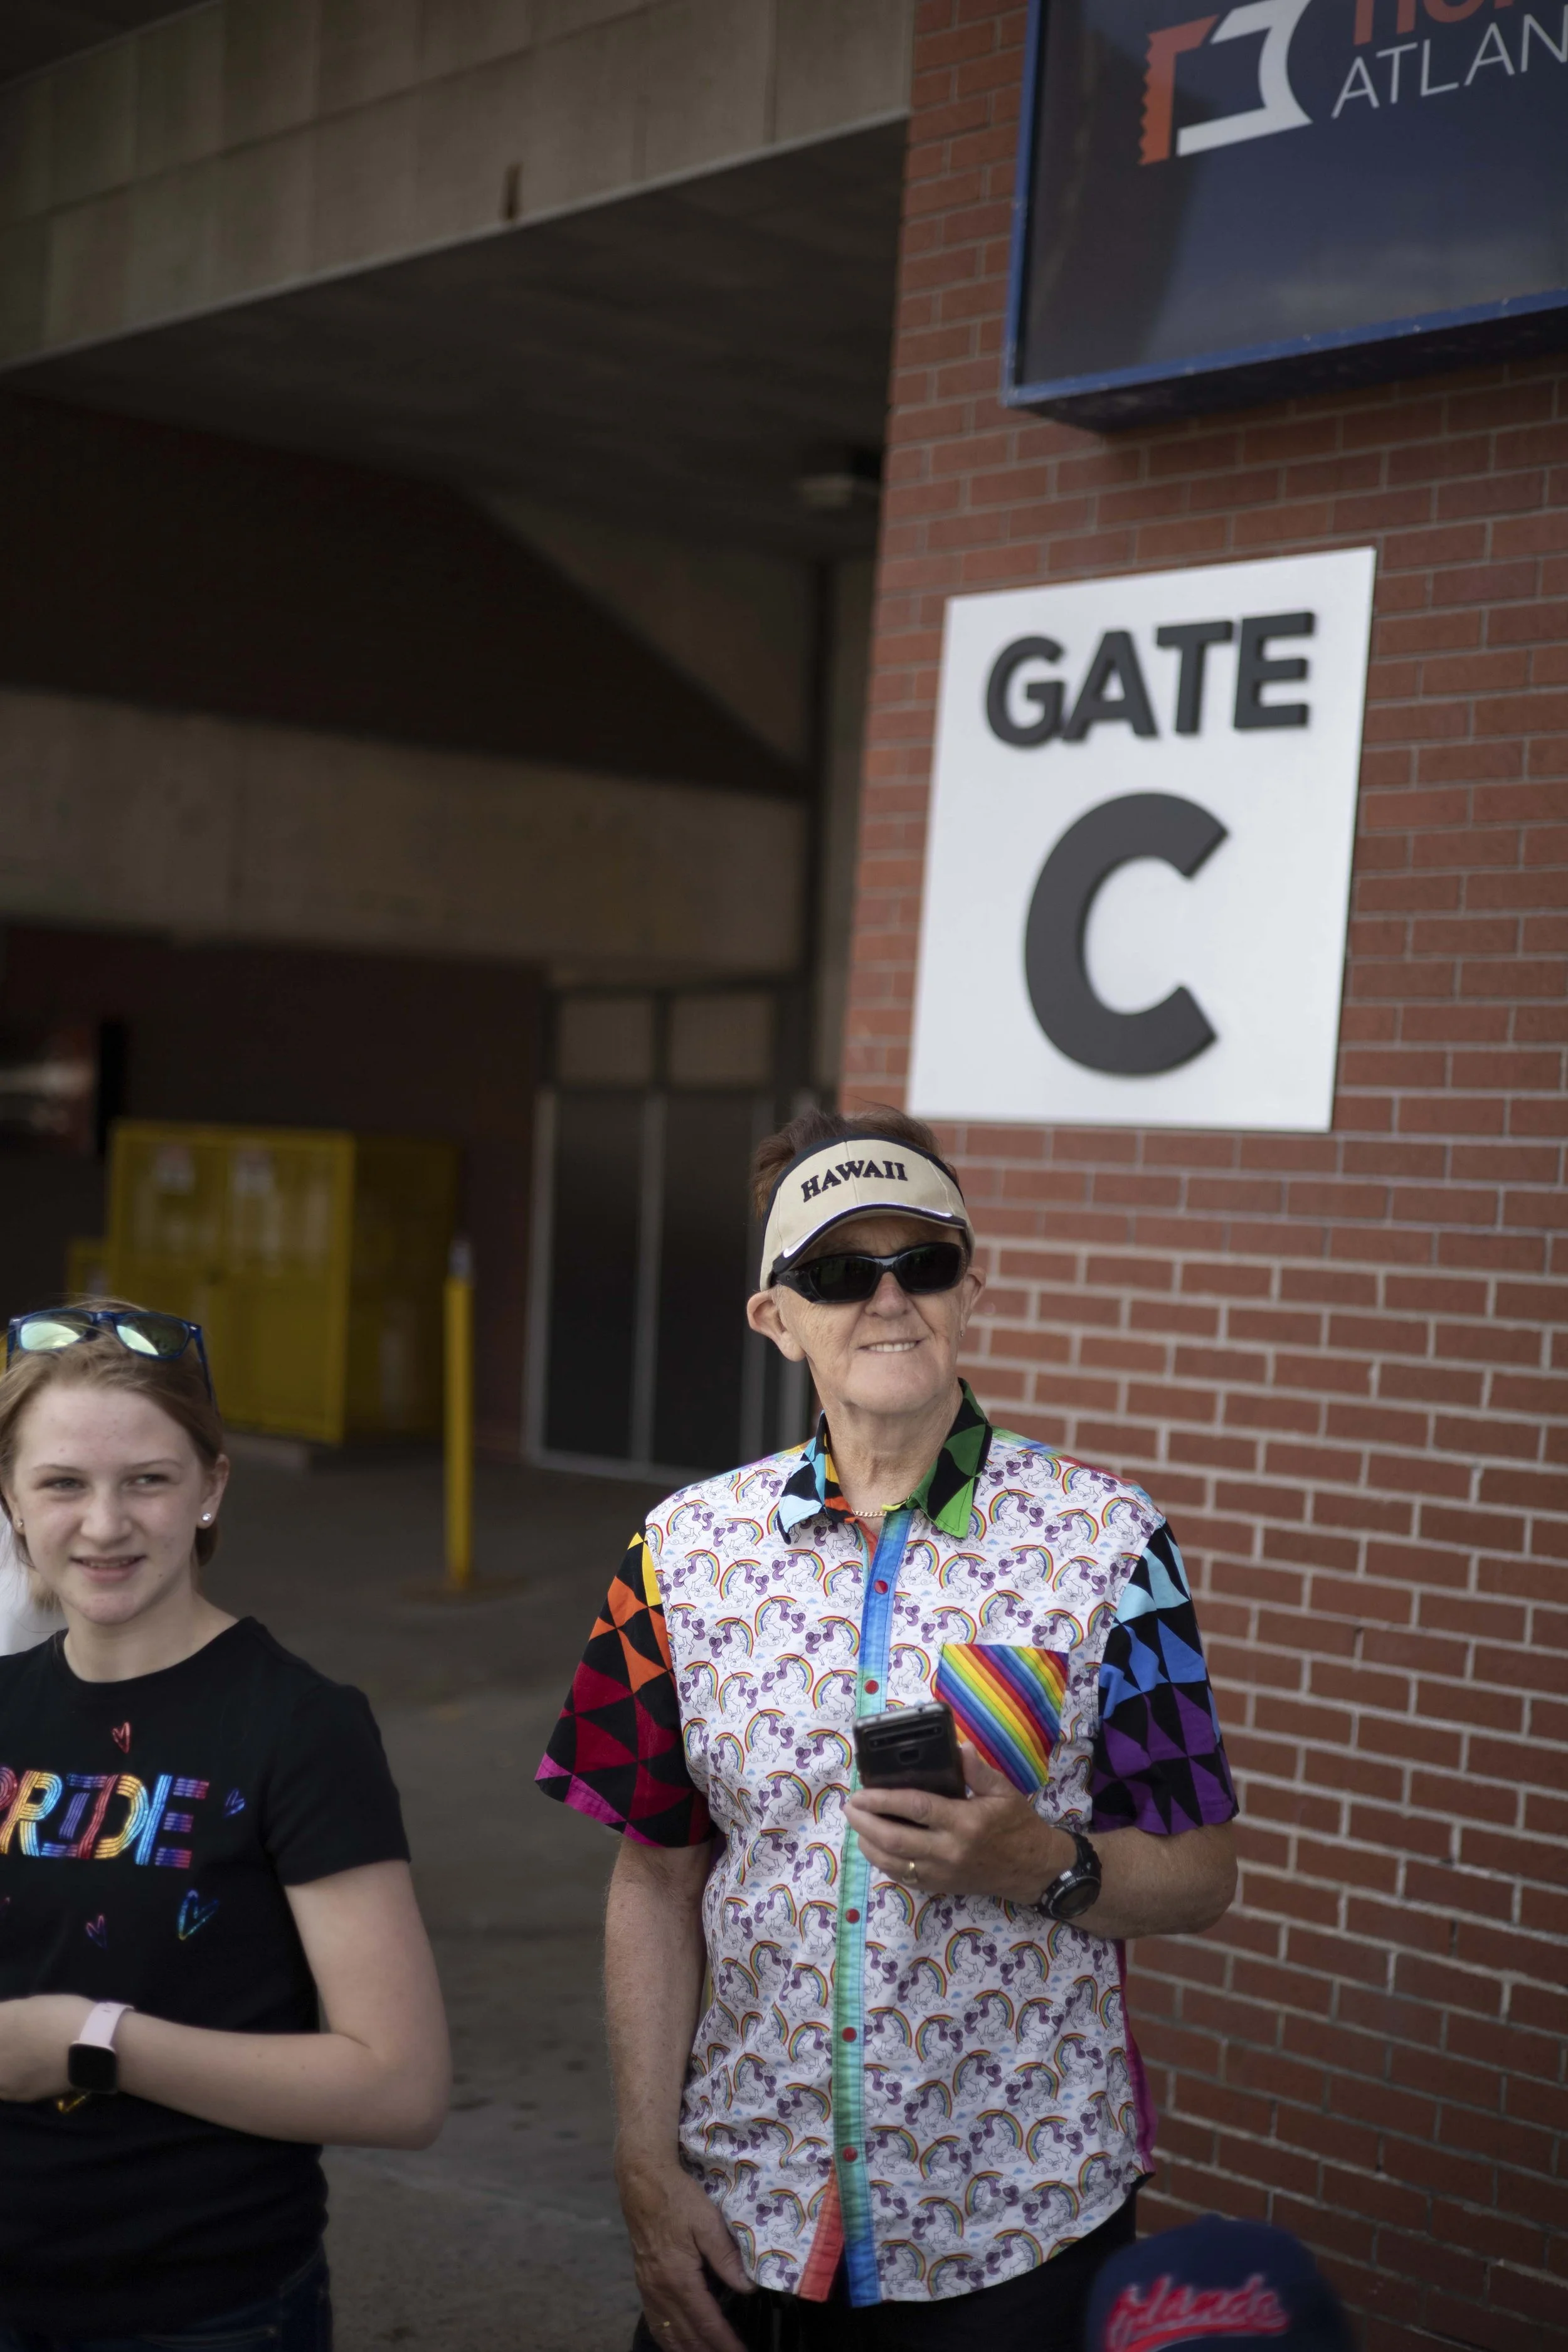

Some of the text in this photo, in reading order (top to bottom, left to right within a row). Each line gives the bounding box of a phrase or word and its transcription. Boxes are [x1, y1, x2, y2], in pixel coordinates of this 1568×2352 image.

[985, 611, 1315, 748] GATE
[1023, 790, 1229, 1078] C
[800, 1159, 908, 1203] HAWAII
